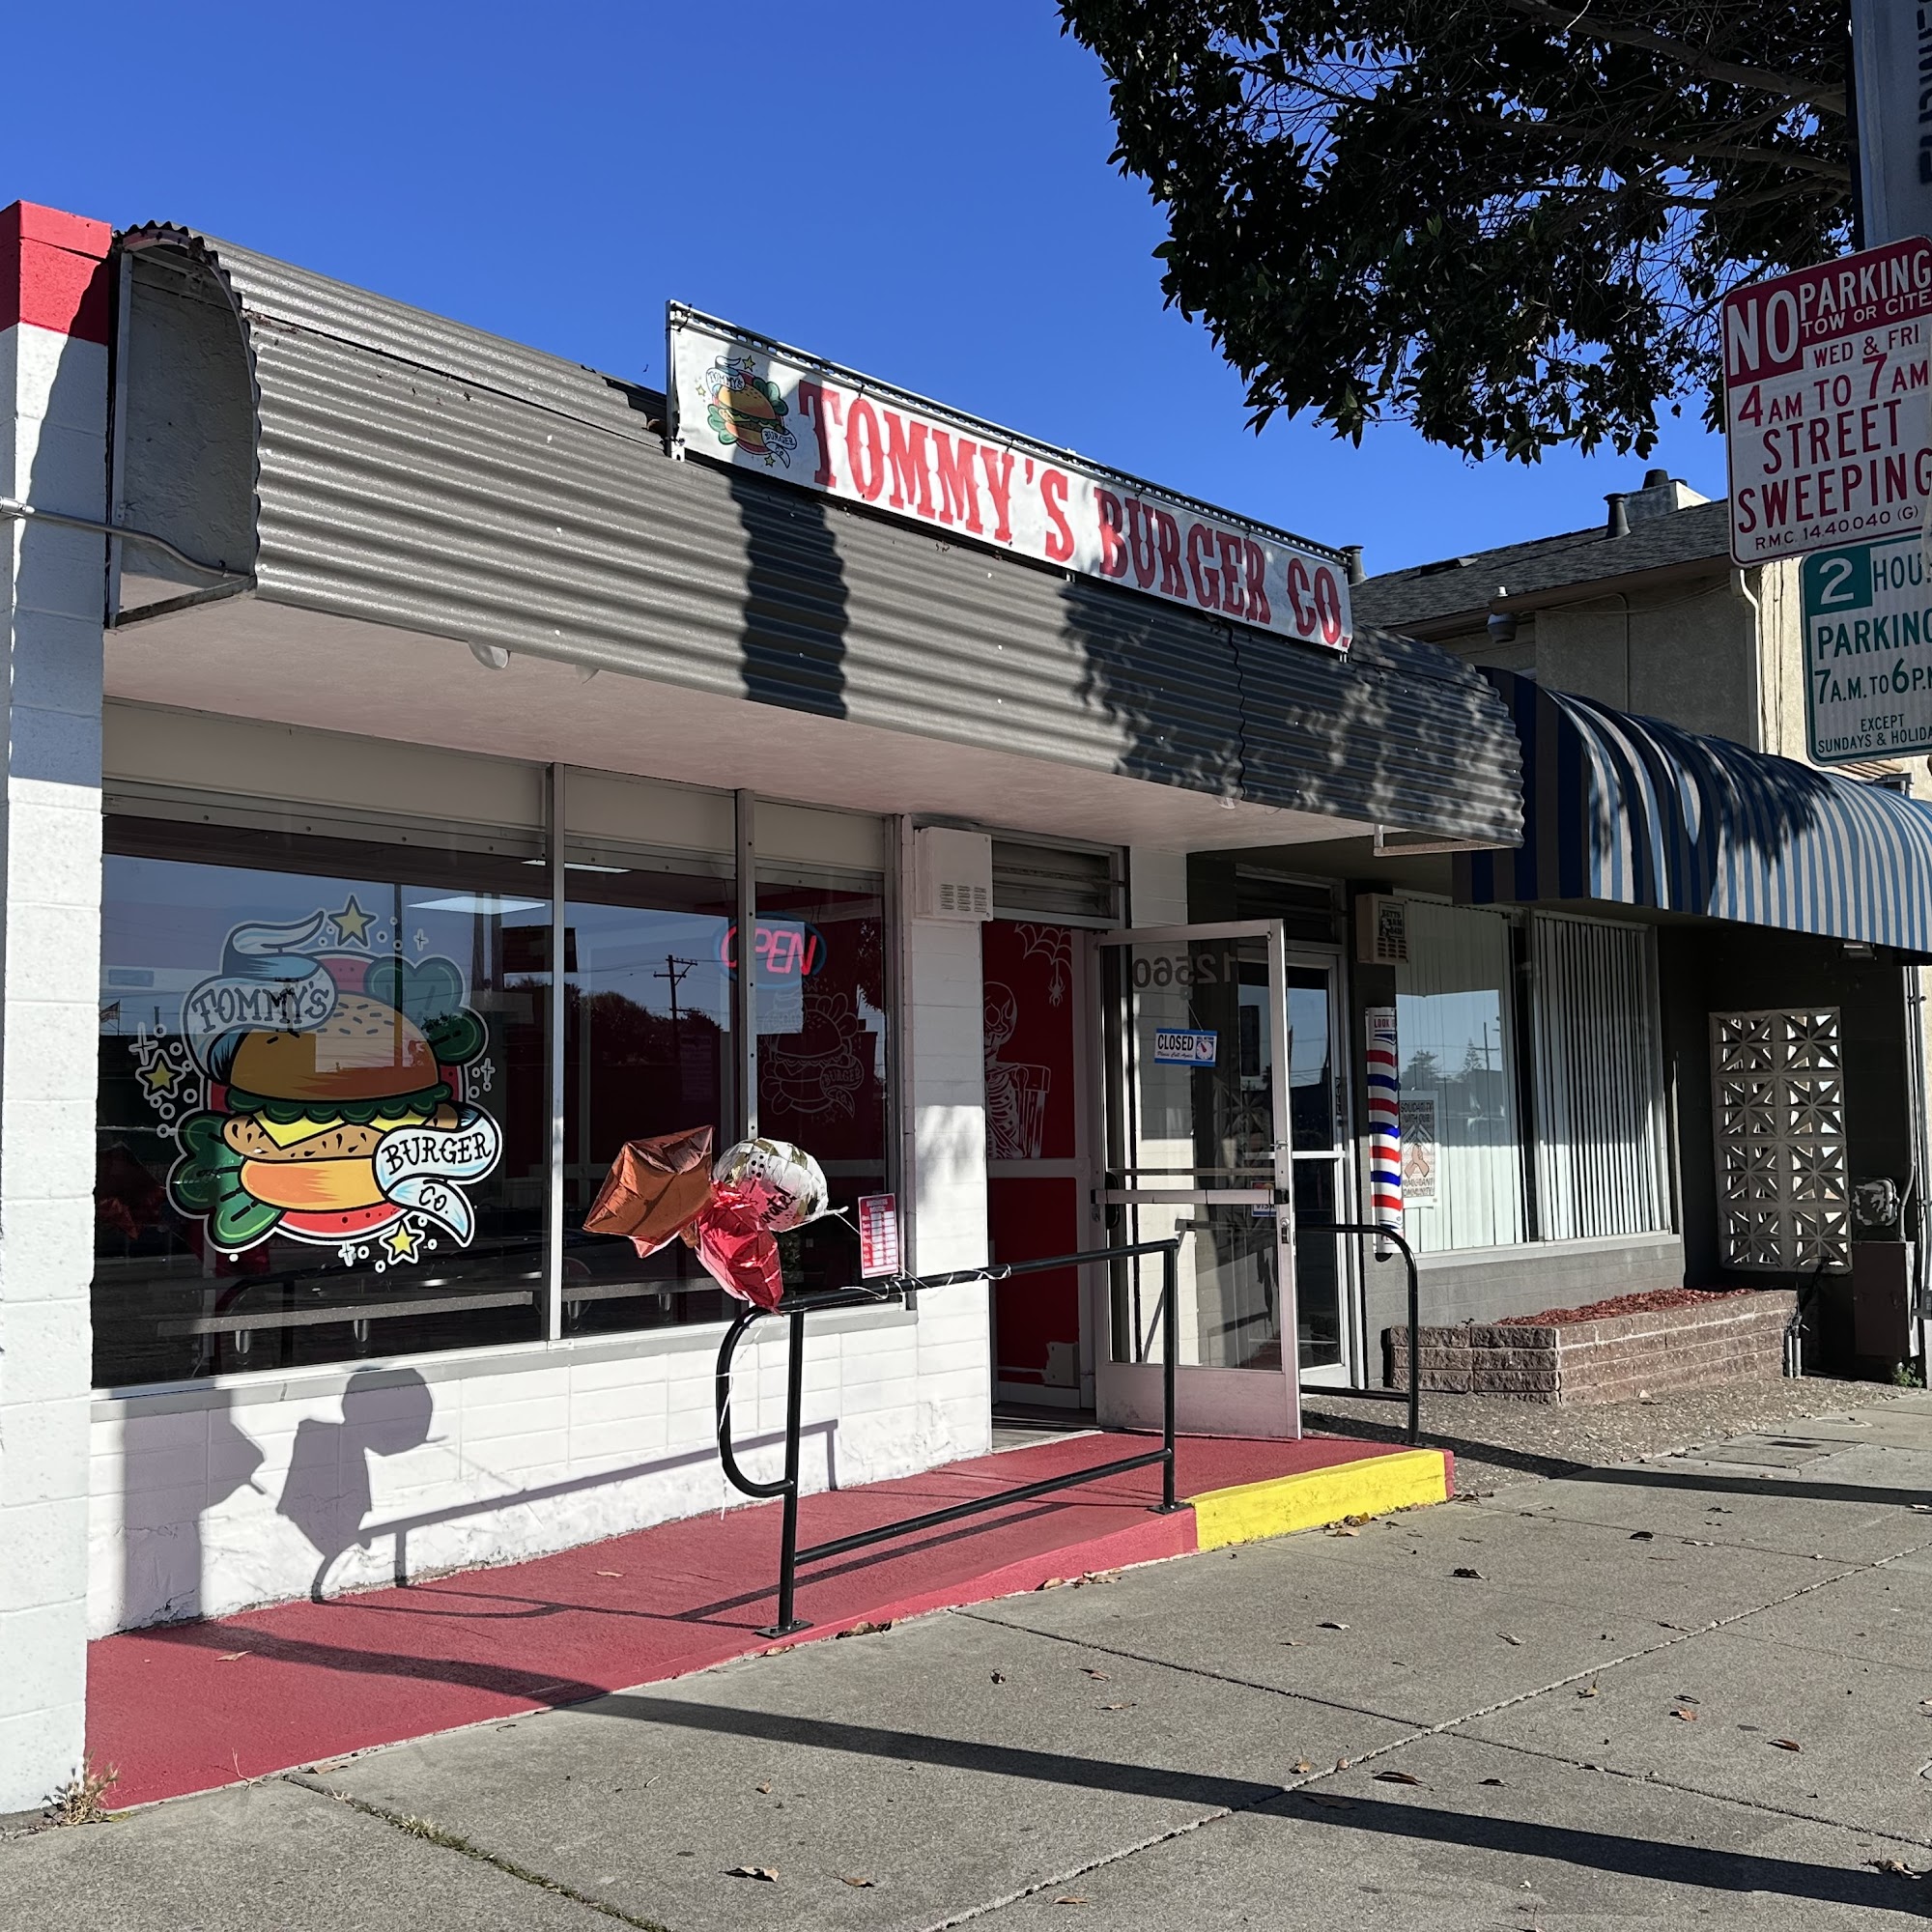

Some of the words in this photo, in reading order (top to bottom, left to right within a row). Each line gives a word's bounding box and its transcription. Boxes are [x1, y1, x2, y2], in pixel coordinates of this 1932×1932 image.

[1726, 289, 1799, 378] NO
[1799, 248, 1931, 322] PARKING
[1801, 310, 1847, 338] TOW
[1853, 305, 1877, 324] OR
[1885, 288, 1932, 316] CITE
[1813, 341, 1854, 368] WED
[1862, 335, 1880, 356] &
[1889, 324, 1919, 351] FRI
[1813, 374, 1852, 412] TO
[762, 430, 794, 445] BURGER
[1763, 398, 1902, 475] STREET
[1738, 447, 1932, 534] SWEEPING
[798, 379, 1075, 562] TOMMY'S
[1094, 486, 1271, 625] BURGER
[1287, 557, 1351, 648] CO.
[1804, 511, 1891, 541] 14.40.040
[1897, 505, 1918, 522] (G)
[1819, 557, 1854, 605] 2
[1873, 553, 1932, 593] HOU
[1869, 674, 1889, 696] TO
[1818, 734, 1872, 753] SUNDAYS
[1876, 732, 1887, 746] &
[1861, 713, 1905, 732] EXCEPT
[191, 980, 331, 1035] TOMMY'S
[1374, 1018, 1391, 1029] LOOK
[1157, 1034, 1194, 1051] CLOSED
[381, 1131, 493, 1176] BURGER
[418, 1185, 449, 1214] CO.
